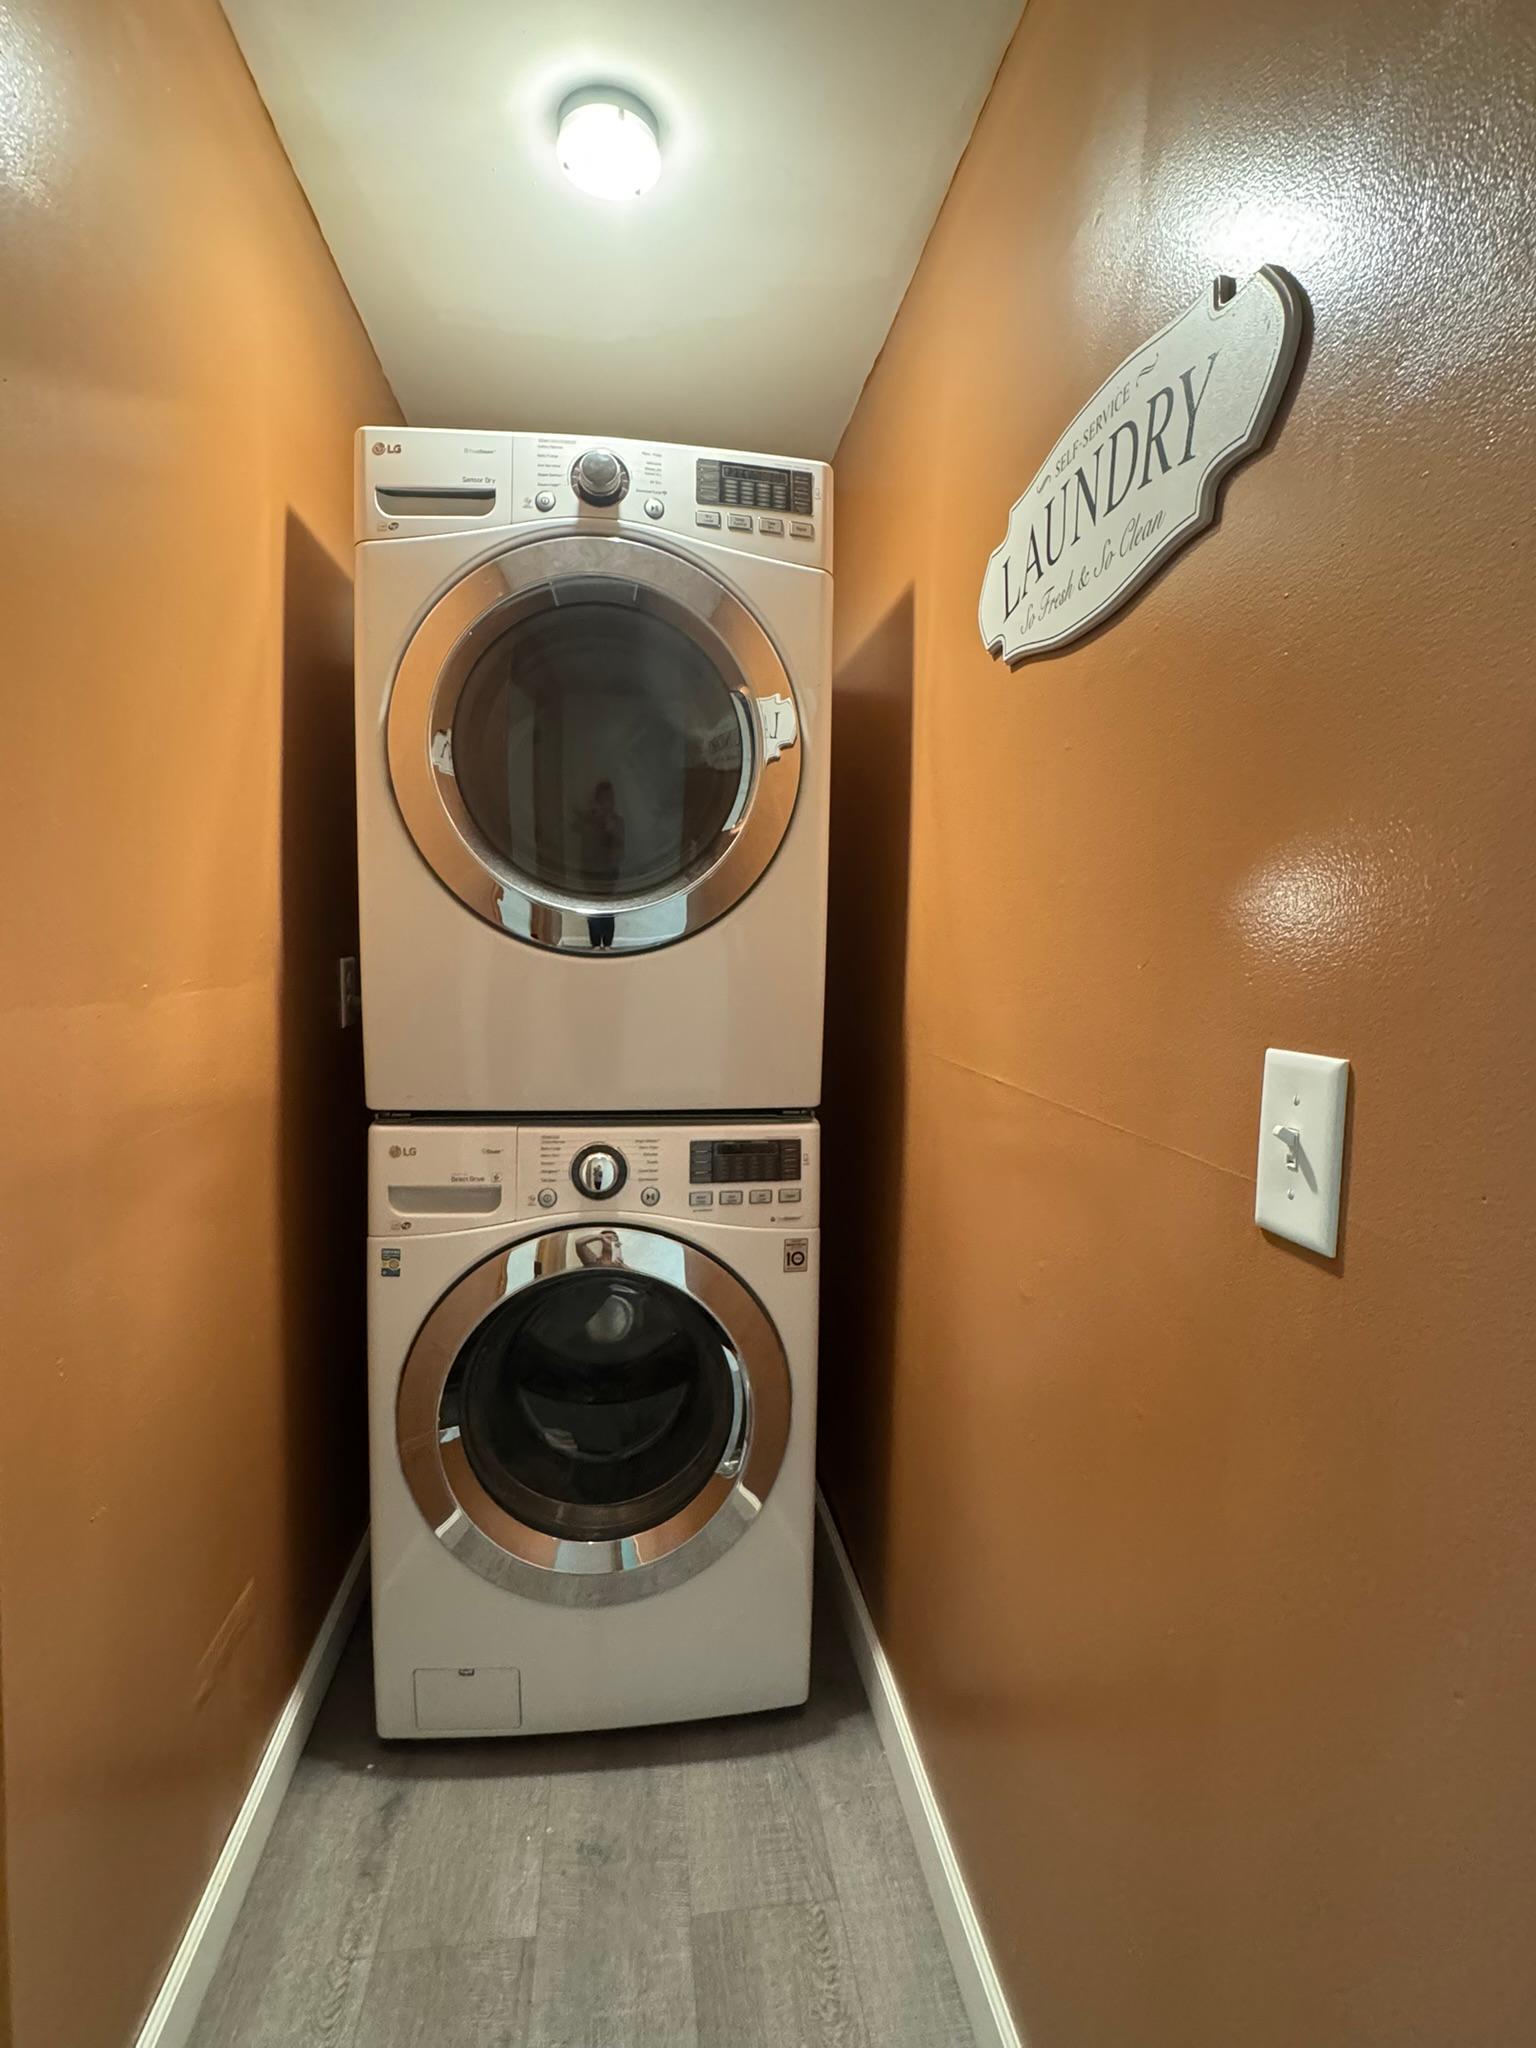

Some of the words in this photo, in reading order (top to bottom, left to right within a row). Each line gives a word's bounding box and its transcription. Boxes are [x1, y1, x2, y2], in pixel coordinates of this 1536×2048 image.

[485, 476, 496, 485] Dry
[1002, 348, 1222, 624] LAUNDRY
[1054, 382, 1131, 479] SELF-SERVICE
[1020, 603, 1036, 635] So
[1038, 570, 1074, 621] Fresh
[1077, 565, 1091, 592] &
[1093, 537, 1116, 579] So
[1119, 508, 1167, 559] Clean
